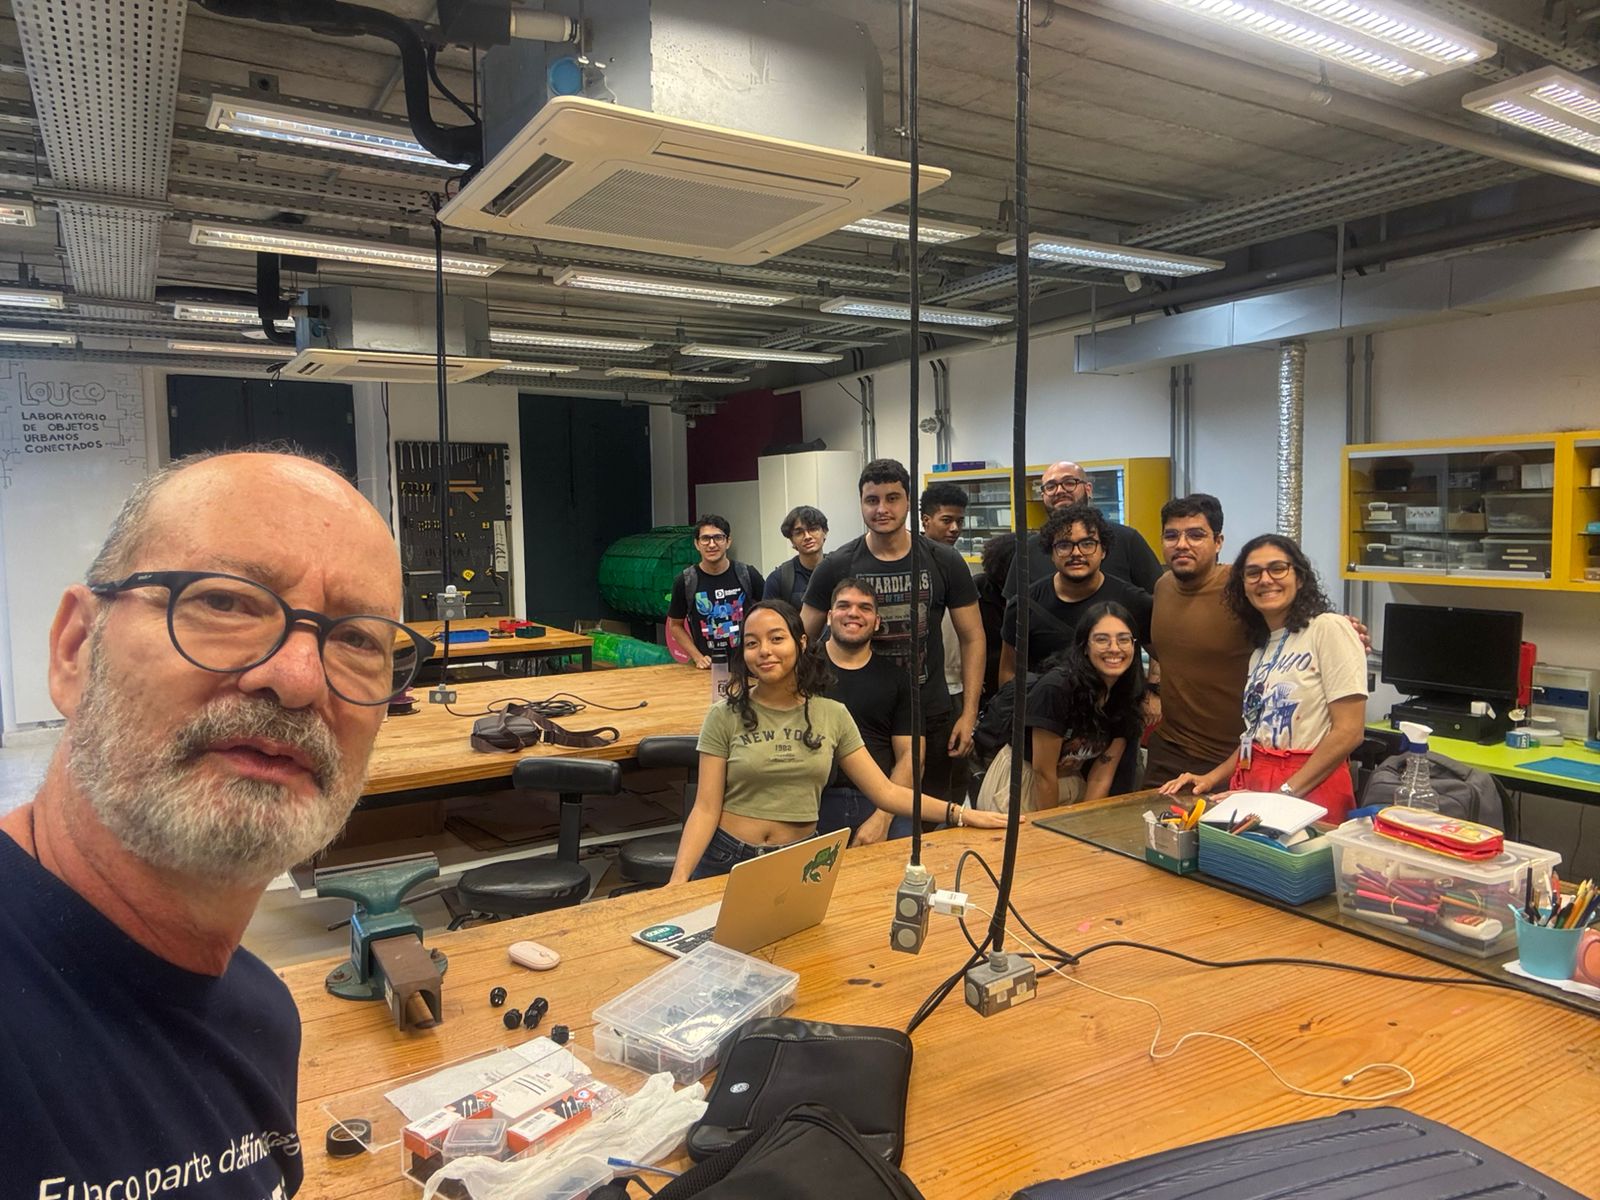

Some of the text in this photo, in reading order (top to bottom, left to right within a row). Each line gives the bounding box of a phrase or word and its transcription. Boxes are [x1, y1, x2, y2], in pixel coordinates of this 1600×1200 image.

[23, 422, 100, 432] DE OBJETOS
[23, 433, 80, 443] URBANOS
[24, 440, 103, 453] CONECTADOS
[740, 730, 775, 746] NEW
[145, 1151, 212, 1200] parte
